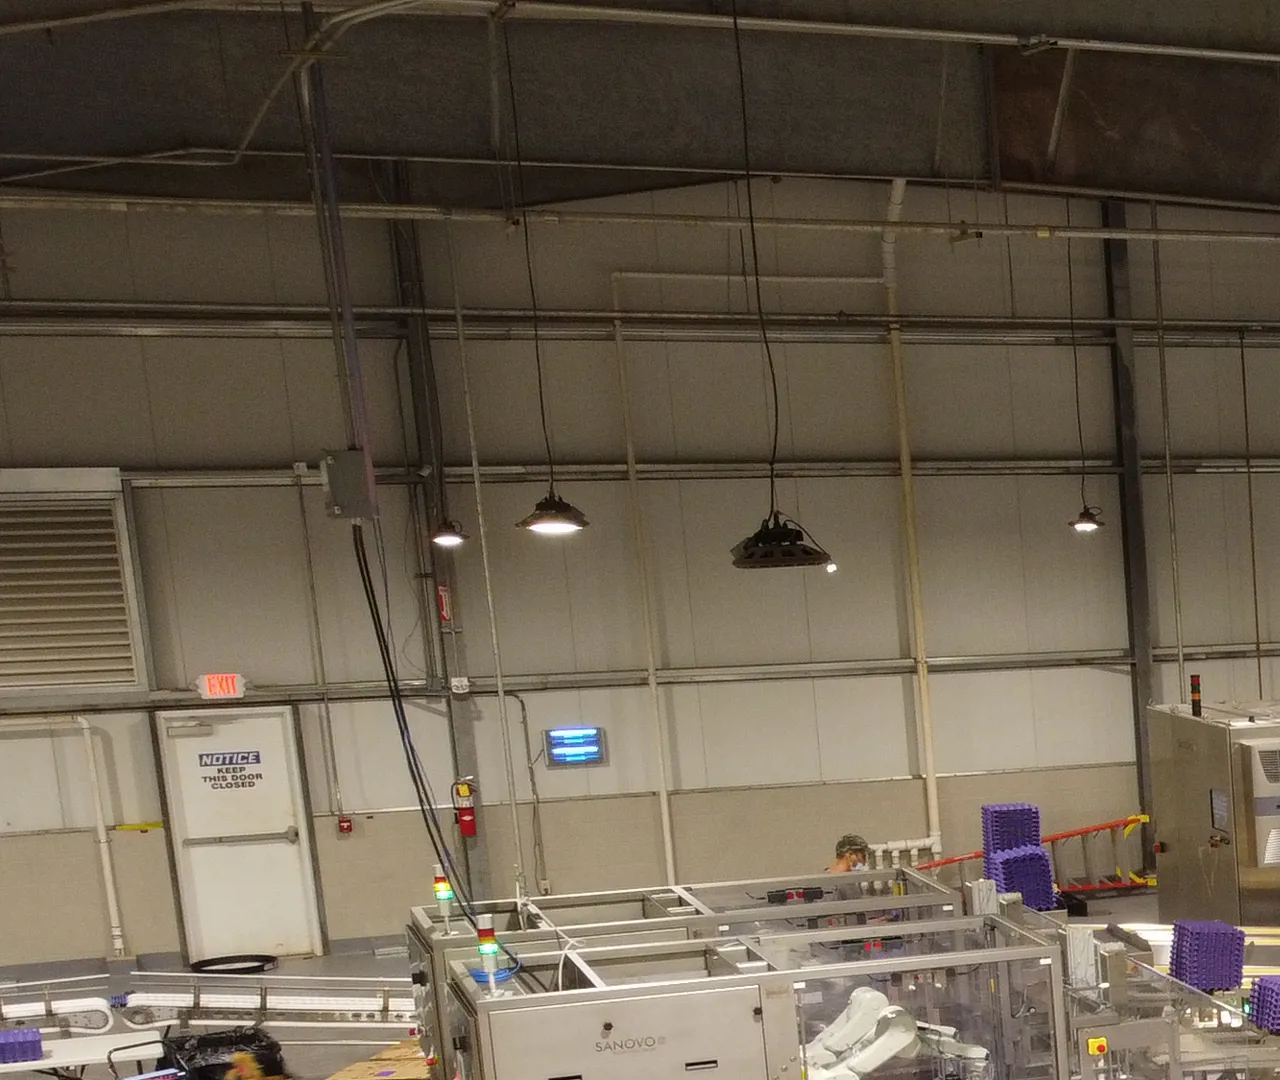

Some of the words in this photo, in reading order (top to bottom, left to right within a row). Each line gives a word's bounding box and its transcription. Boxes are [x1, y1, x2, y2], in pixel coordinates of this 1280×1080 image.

[206, 674, 238, 697] EXIT
[200, 752, 258, 766] NOTICE
[216, 766, 247, 775] KEEP
[201, 774, 228, 783] THIS
[231, 773, 263, 782] DOOR
[211, 781, 256, 790] CLOSED
[595, 1036, 656, 1053] SANOVO
